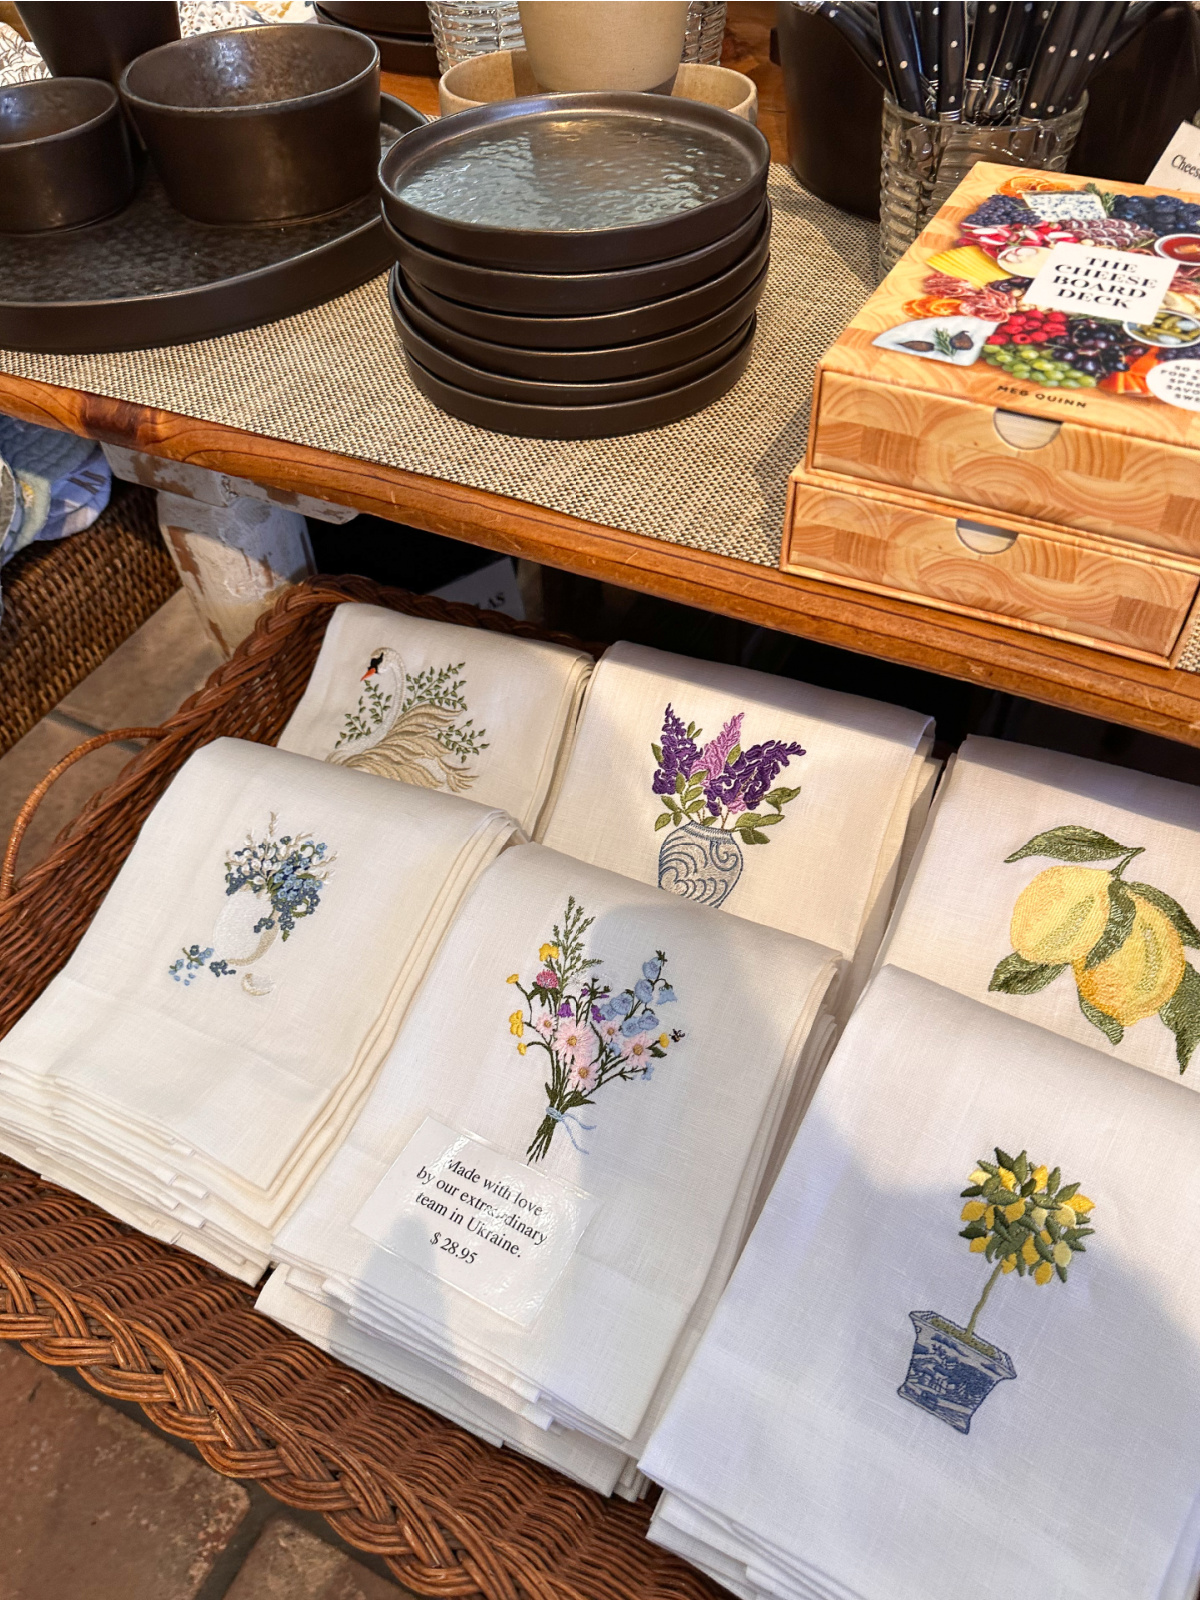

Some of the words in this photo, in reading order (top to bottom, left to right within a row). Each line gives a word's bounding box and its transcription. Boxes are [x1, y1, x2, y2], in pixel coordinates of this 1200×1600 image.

[1171, 154, 1200, 180] Chees
[1055, 264, 1158, 289] CHEESE
[1086, 256, 1138, 273] THE
[1052, 275, 1146, 299] BOARD
[1056, 288, 1132, 310] DECK
[1160, 369, 1186, 378] FOR
[997, 385, 1029, 397] MEG
[1035, 393, 1087, 408] QUINN
[416, 1166, 436, 1185] by
[436, 1179, 460, 1196] our
[448, 1159, 481, 1183] Made
[483, 1178, 511, 1200] with
[514, 1192, 543, 1216] love
[415, 1192, 449, 1216] team
[449, 1207, 465, 1225] in
[466, 1217, 521, 1258] Ukraine.
[430, 1231, 442, 1245] $
[440, 1237, 478, 1264] 28.95
